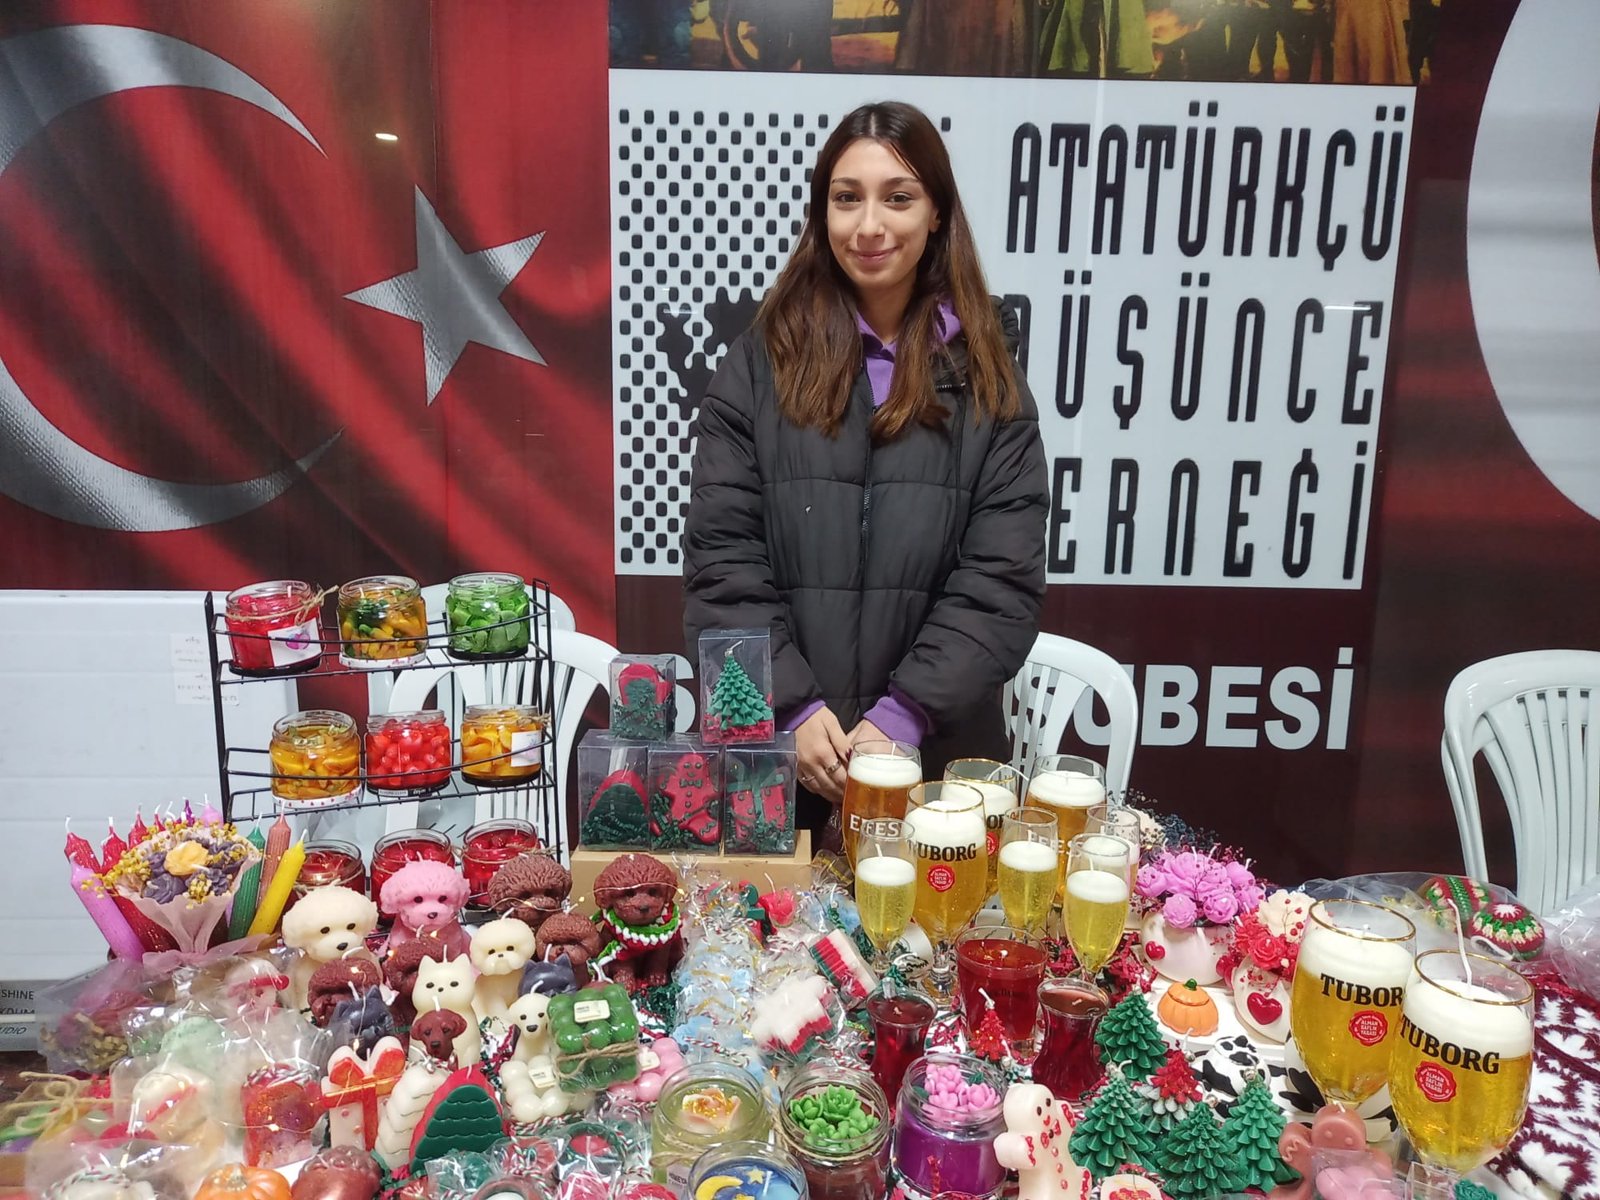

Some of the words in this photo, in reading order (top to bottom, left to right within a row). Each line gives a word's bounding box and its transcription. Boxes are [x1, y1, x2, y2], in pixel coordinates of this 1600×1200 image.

[1005, 100, 1406, 271] ATATÜRKÇÜ
[1046, 440, 1368, 581] ERNEĞİ
[0, 989, 34, 1000] SHINE
[1320, 973, 1403, 1007] TUBOR
[1400, 1014, 1500, 1074] TUBORG
